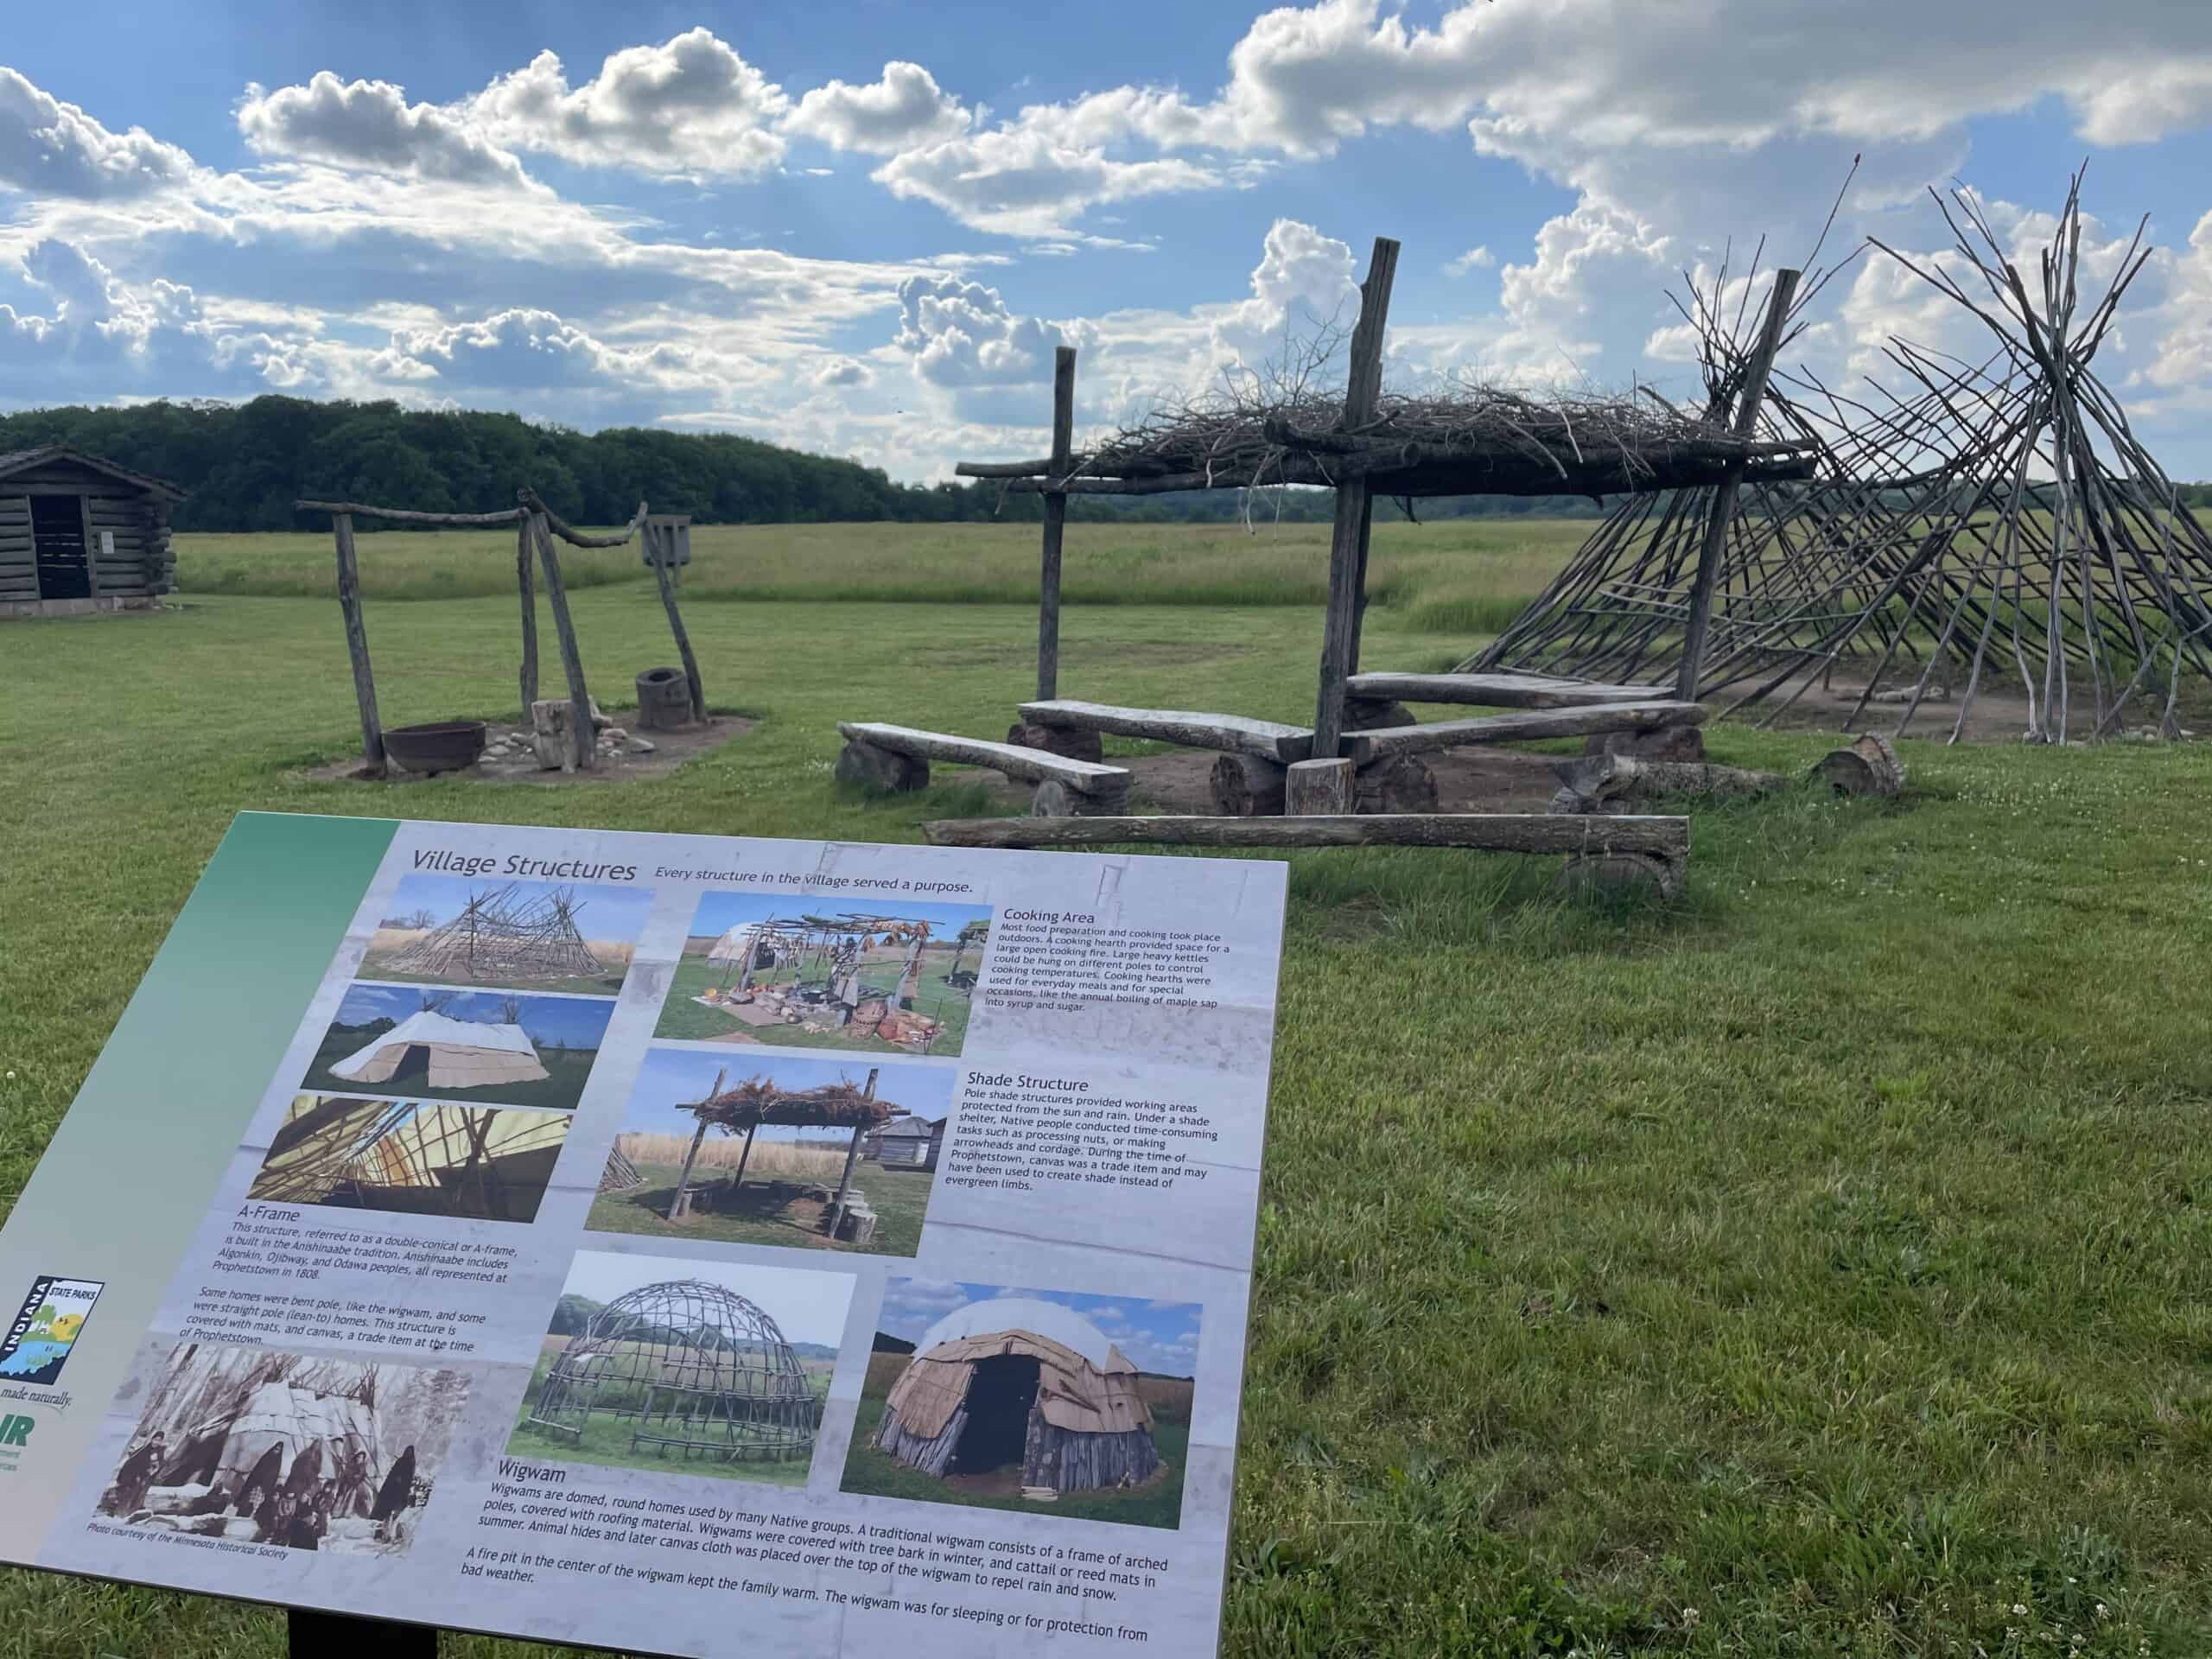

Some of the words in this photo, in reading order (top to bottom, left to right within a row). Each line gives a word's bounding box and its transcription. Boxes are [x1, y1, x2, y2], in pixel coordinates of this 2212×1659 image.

[413, 849, 496, 877] Village
[504, 854, 639, 880] Structures
[655, 865, 692, 881] Every
[695, 868, 758, 881] structure
[760, 869, 774, 882] in
[778, 871, 801, 883] the
[803, 872, 849, 888] village
[853, 875, 899, 887] served
[901, 880, 911, 888] a
[913, 880, 972, 893] purpose.
[1003, 908, 1058, 925] Cooking
[1061, 911, 1096, 923] Area
[1001, 922, 1022, 931] Most
[1025, 924, 1047, 932] food
[1048, 926, 1106, 936] preparation
[1108, 928, 1127, 937] and
[1128, 930, 1166, 940] cooking
[1192, 932, 1221, 942] place
[1046, 935, 1053, 944] A
[1053, 937, 1091, 947] cooking
[1094, 938, 1127, 947] hearth
[1128, 940, 1173, 950] provided
[1205, 944, 1219, 952] for
[985, 997, 1004, 1006] into
[1006, 1001, 1033, 1010] syrup
[968, 1072, 1013, 1086] Shade
[1016, 1075, 1090, 1091] Structure
[964, 1088, 986, 1098] Pole
[988, 1090, 1019, 1100] shade
[1020, 1093, 1073, 1103] structures
[1075, 1097, 1122, 1107] provided
[1123, 1100, 1166, 1112] working
[961, 1103, 1013, 1112] protected
[1014, 1103, 1039, 1114] from
[1042, 1106, 1060, 1116] the
[1083, 1109, 1104, 1118] and
[1105, 1110, 1129, 1120] rain.
[1134, 1111, 1165, 1122] Under
[1178, 1115, 1211, 1125] shade
[959, 1113, 995, 1124] shelter,
[1000, 1115, 1033, 1126] Native
[1035, 1119, 1072, 1130] people
[1074, 1121, 1131, 1132] conducted
[1133, 1124, 1219, 1140] time-consuming
[945, 1177, 998, 1187] evergreen
[1000, 1179, 1033, 1190] limbs.
[948, 1162, 973, 1173] have
[975, 1164, 1002, 1174] been
[1003, 1167, 1033, 1177] used
[1032, 1169, 1045, 1178] to
[1046, 1172, 1082, 1180] create
[1084, 1173, 1116, 1183] shade
[1118, 1174, 1160, 1186] instead
[1160, 1179, 1175, 1187] of
[238, 1205, 302, 1221] A-Frame
[232, 1221, 251, 1232] This
[304, 1228, 347, 1241] referred
[348, 1232, 360, 1242] to
[384, 1234, 459, 1250] double-conical
[312, 1255, 333, 1266] and
[333, 1256, 367, 1269] Odawa
[415, 1265, 429, 1275] all
[431, 1268, 494, 1281] represented
[495, 1274, 509, 1282] at
[49, 1287, 72, 1298] STATE
[70, 1289, 96, 1300] PARKS
[200, 1285, 226, 1298] Some
[228, 1287, 261, 1300] homes
[264, 1294, 289, 1304] were
[291, 1294, 315, 1306] bent
[346, 1300, 365, 1311] like
[367, 1302, 387, 1313] the
[435, 1309, 457, 1319] and
[458, 1313, 487, 1323] some
[3, 1282, 49, 1351] INDIANA
[194, 1301, 219, 1311] were
[220, 1303, 259, 1317] straight
[260, 1306, 283, 1319] pole
[285, 1307, 333, 1325] (lean-to)
[374, 1317, 395, 1328] This
[397, 1320, 445, 1333] structure
[448, 1324, 458, 1335] is
[1, 1387, 28, 1401] made
[498, 1459, 568, 1481] Wigwam
[492, 1480, 541, 1497] Wigwams
[544, 1490, 563, 1500] are
[565, 1489, 606, 1507] domed,
[612, 1497, 646, 1510] round
[647, 1498, 685, 1515] homes
[688, 1505, 716, 1518] used
[718, 1506, 732, 1523] by
[735, 1511, 766, 1527] many
[770, 1512, 808, 1529] Native
[810, 1521, 852, 1536] groups.
[857, 1522, 868, 1535] A
[868, 1525, 933, 1543] traditional
[935, 1532, 985, 1549] wigwam
[988, 1541, 1036, 1554] consists
[1039, 1544, 1052, 1556] of
[1055, 1548, 1064, 1558] a
[1067, 1547, 1104, 1562] frame
[1107, 1552, 1122, 1565] of
[1124, 1555, 1171, 1570] arched
[479, 1516, 523, 1529] summer.
[528, 1518, 568, 1535] Animal
[570, 1522, 601, 1539] hides
[603, 1529, 626, 1541] and
[627, 1529, 656, 1545] later
[658, 1537, 698, 1550] canvas
[701, 1539, 733, 1554] cloth
[734, 1546, 758, 1557] was
[759, 1547, 801, 1562] placed
[803, 1554, 829, 1566] over
[833, 1554, 854, 1568] the
[857, 1558, 878, 1575] top
[880, 1560, 894, 1573] of
[897, 1562, 918, 1576] the
[920, 1566, 971, 1582] wigwam
[974, 1572, 988, 1585] to
[991, 1576, 1025, 1591] repel
[1027, 1579, 1052, 1592] rain
[1055, 1582, 1080, 1595] and
[1082, 1587, 1116, 1600] snow.
[461, 1561, 483, 1576] bad
[485, 1567, 535, 1581] weather.
